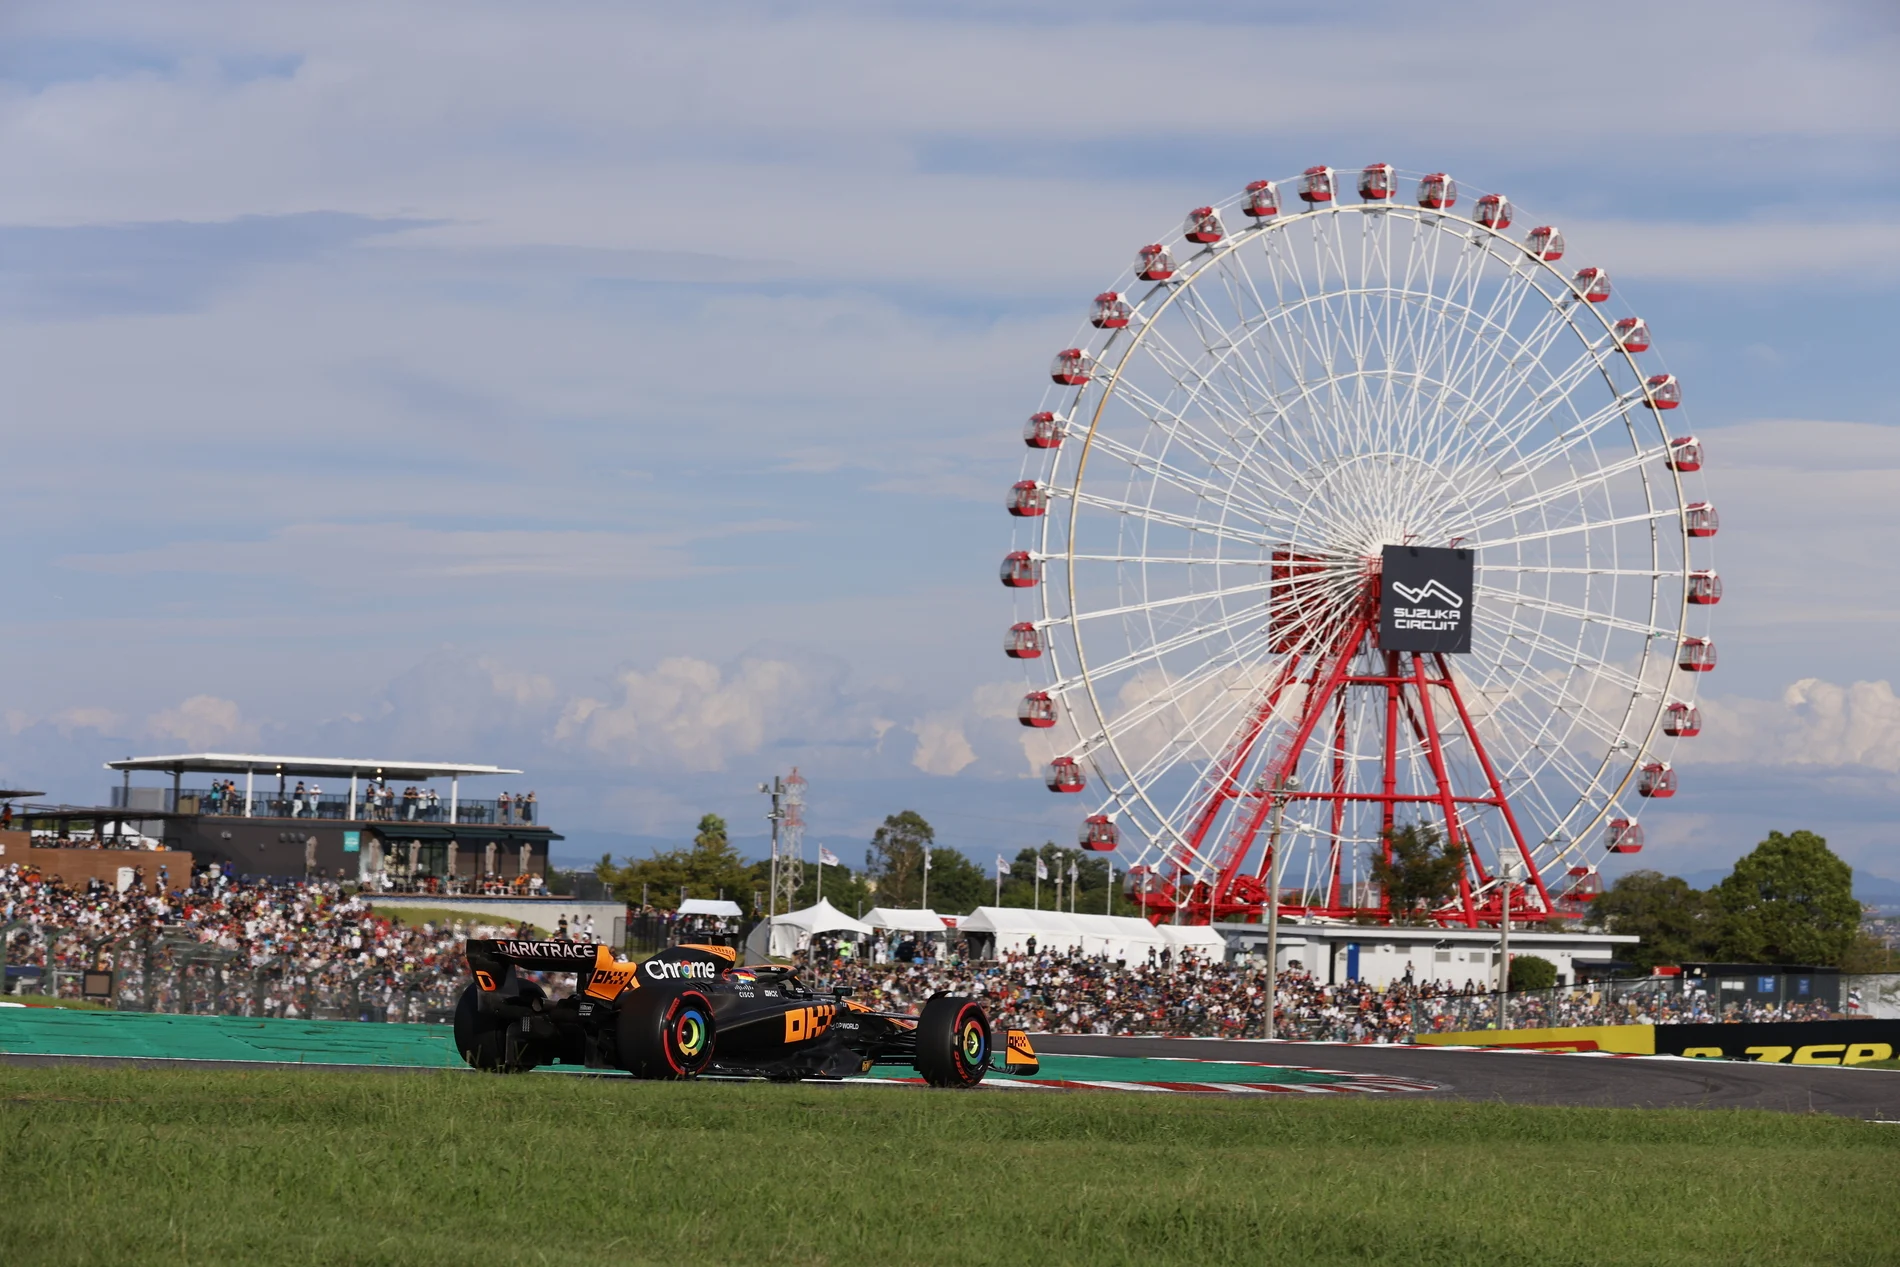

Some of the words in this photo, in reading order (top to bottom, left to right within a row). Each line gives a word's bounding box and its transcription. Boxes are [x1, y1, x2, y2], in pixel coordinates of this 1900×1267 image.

[1393, 607, 1461, 620] SUZUKA
[1394, 619, 1459, 631] CIRCUIT
[497, 941, 596, 958] DARKTRACE
[645, 960, 715, 980] Chrome
[784, 1004, 837, 1043] OKX
